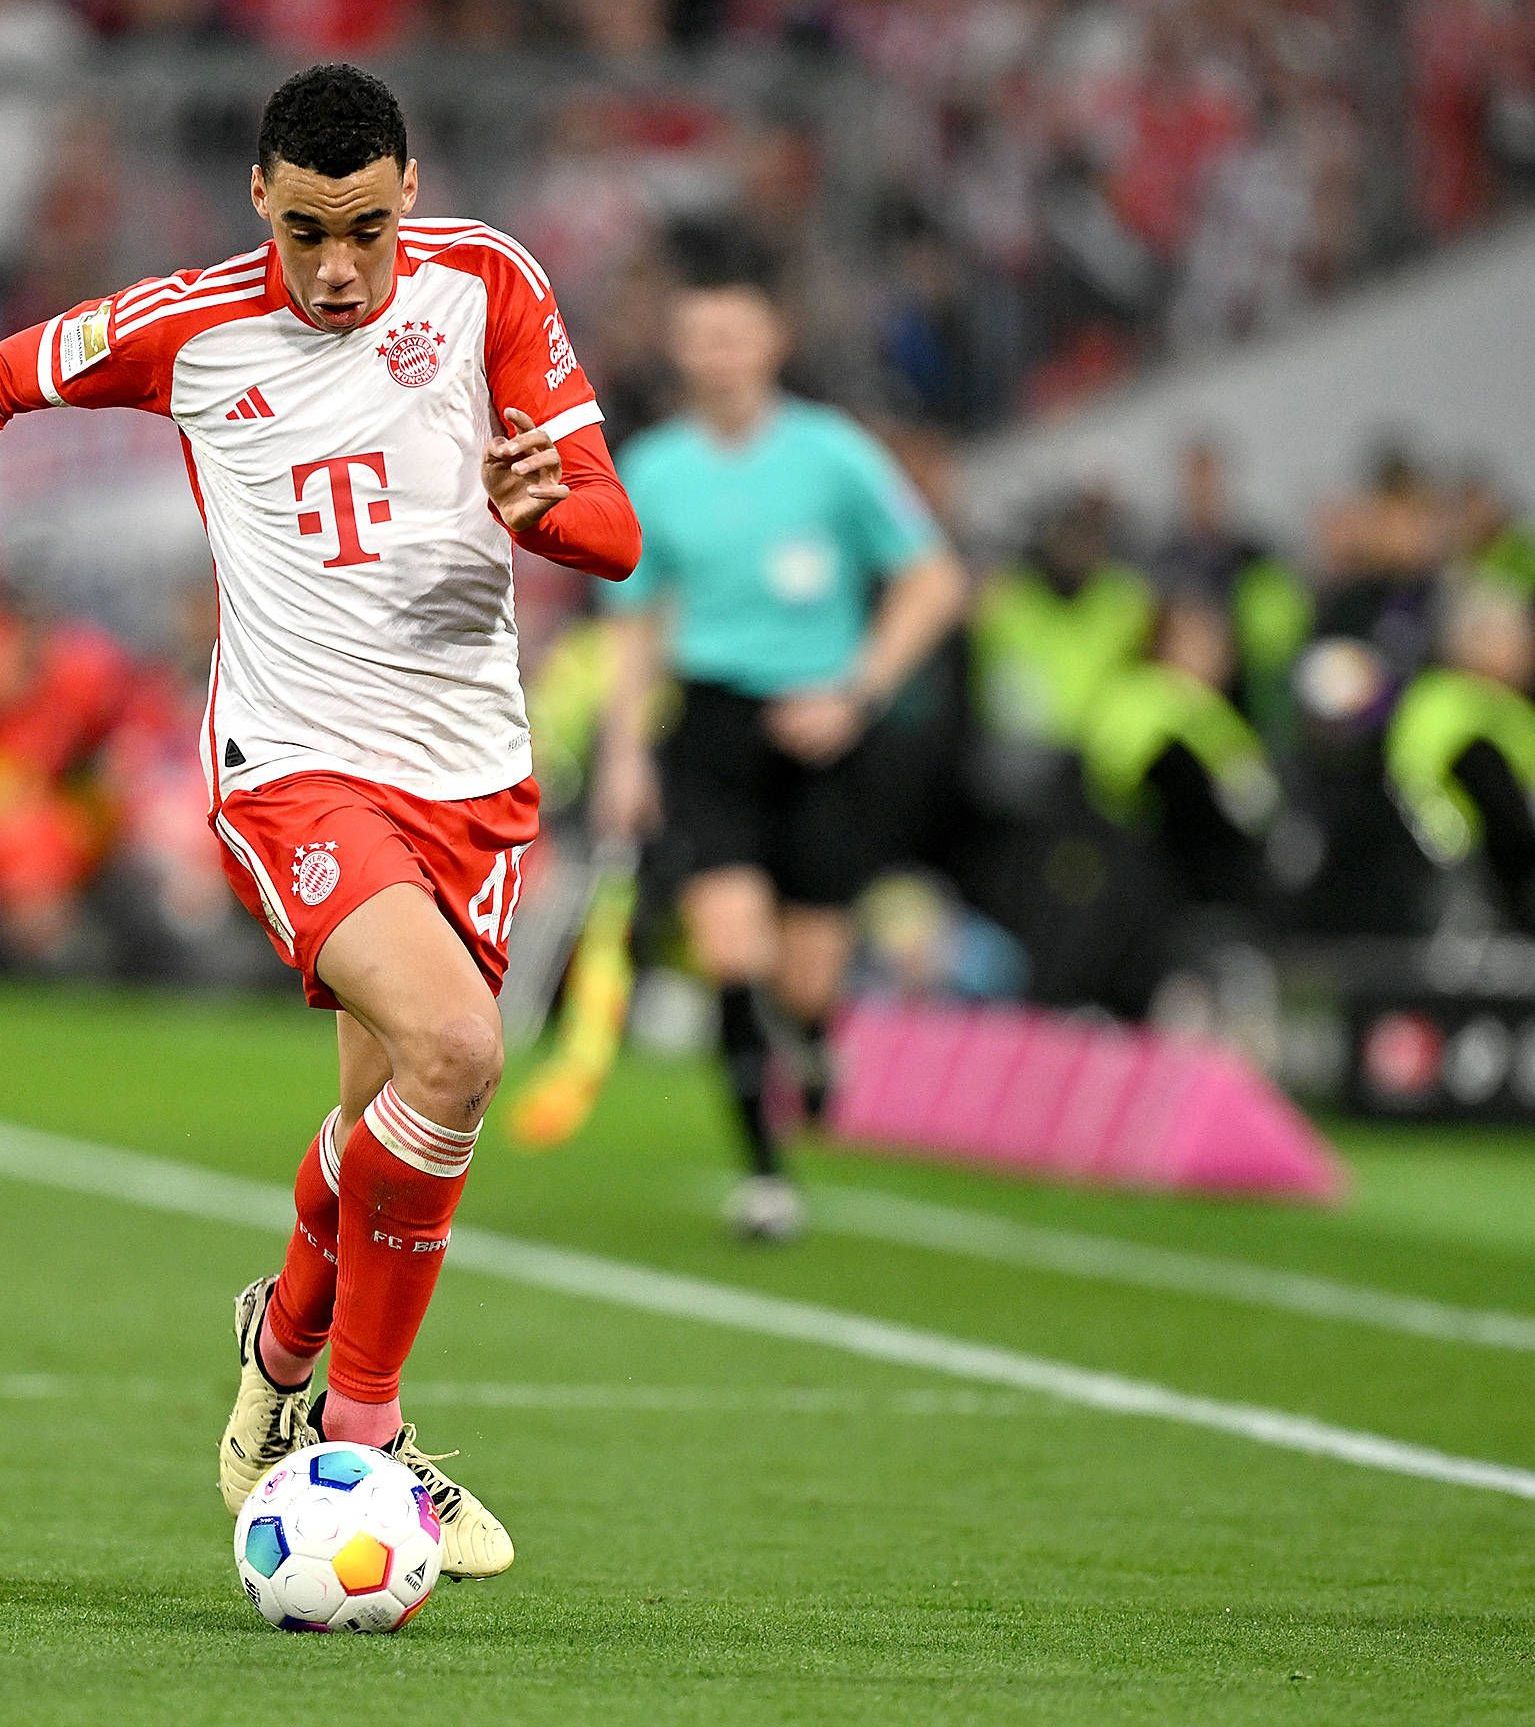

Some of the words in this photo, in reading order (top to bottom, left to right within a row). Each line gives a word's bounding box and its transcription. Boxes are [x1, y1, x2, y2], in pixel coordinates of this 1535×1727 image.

[401, 336, 435, 356] BAYERN
[291, 451, 390, 569] T
[373, 1230, 403, 1250] FC
[404, 1573, 422, 1592] SELECT
